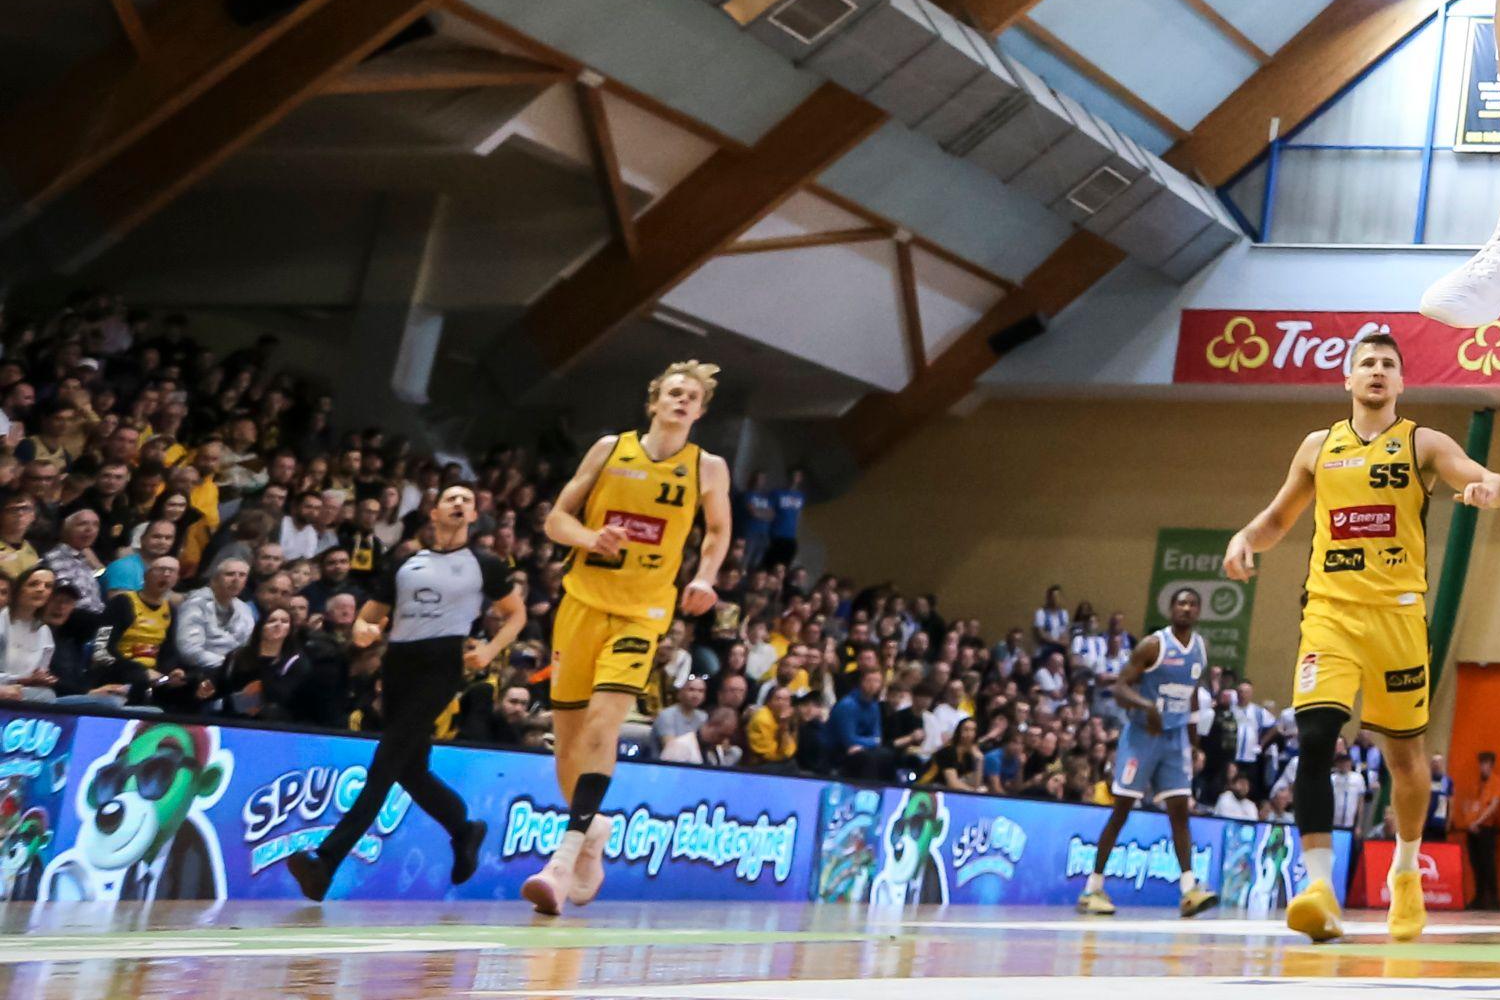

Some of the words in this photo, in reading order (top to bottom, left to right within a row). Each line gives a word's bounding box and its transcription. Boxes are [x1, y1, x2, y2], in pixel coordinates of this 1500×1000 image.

[1272, 320, 1391, 377] Tref
[1369, 463, 1411, 489] 55
[655, 482, 686, 507] 11
[1349, 512, 1391, 525] Energa
[1163, 550, 1225, 578] Ener
[242, 765, 413, 841] SPYGY
[625, 807, 675, 876] Gry
